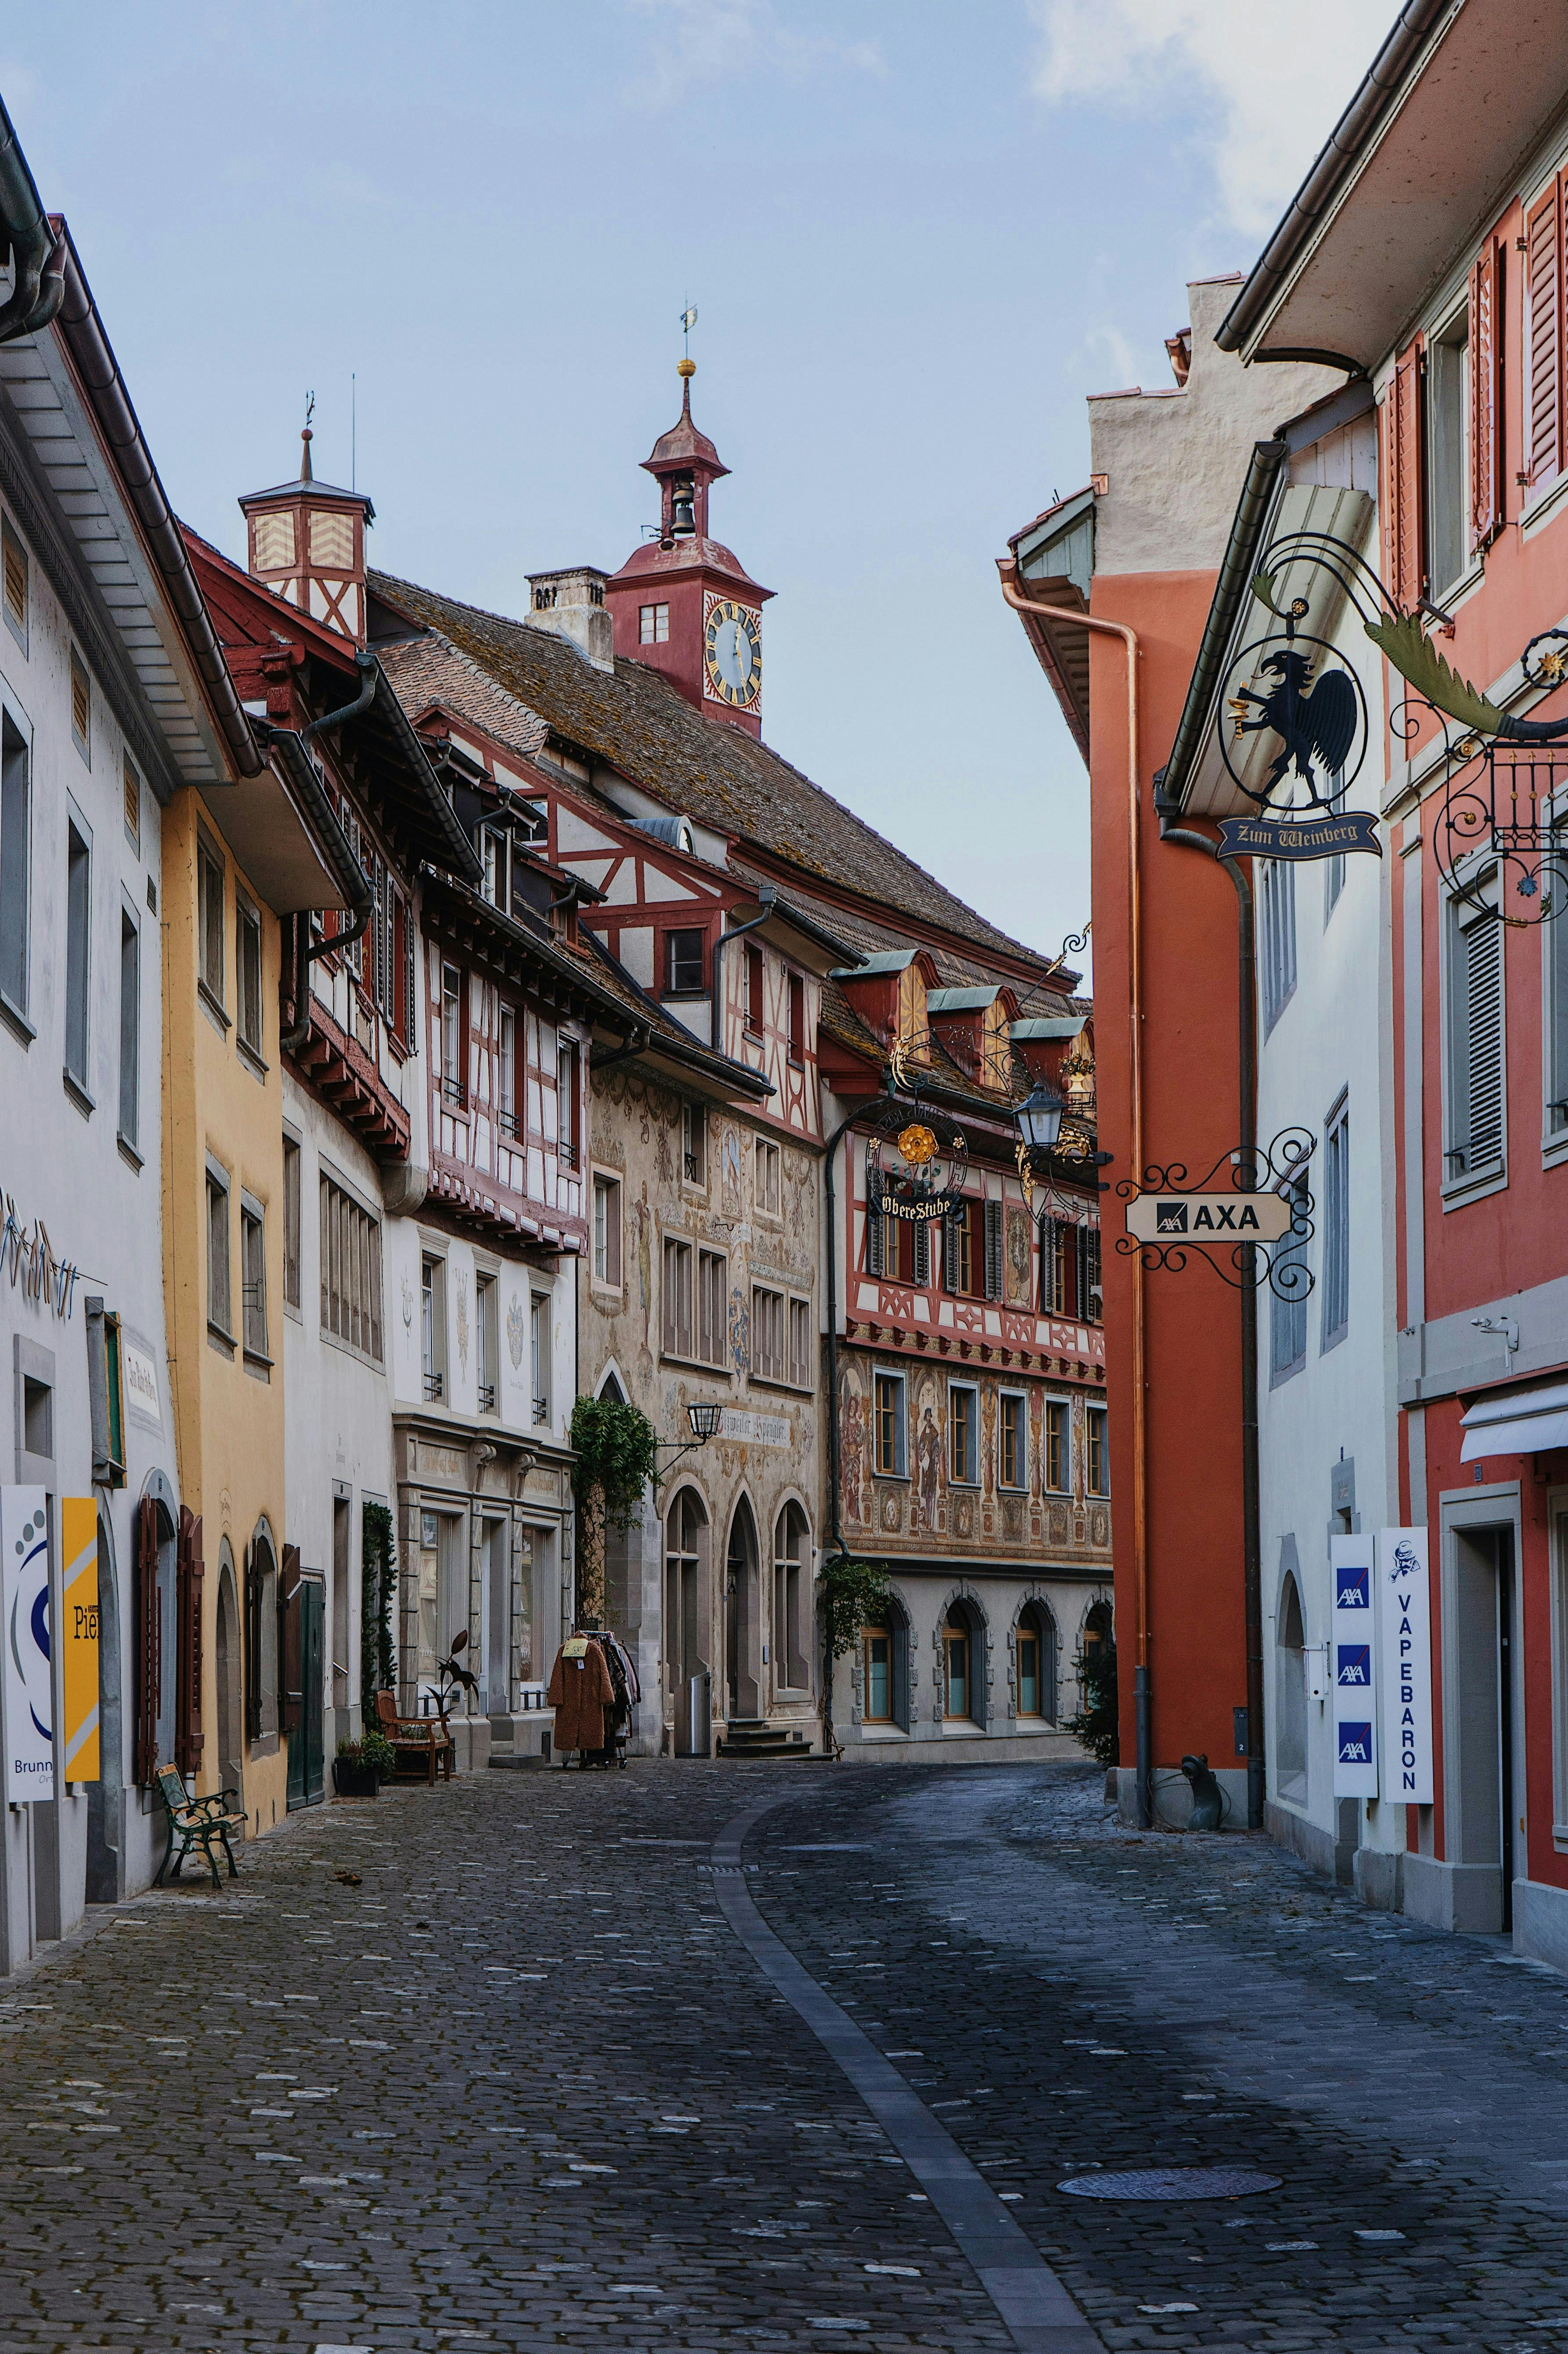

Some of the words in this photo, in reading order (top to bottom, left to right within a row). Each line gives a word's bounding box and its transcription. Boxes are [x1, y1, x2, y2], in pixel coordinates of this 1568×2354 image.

[1236, 825, 1272, 845] Zum
[1278, 825, 1359, 848] Weinberg
[1157, 1218, 1183, 1231] AXA
[1193, 1205, 1260, 1230] AXA
[1337, 1588, 1363, 1605] AXA
[73, 1606, 99, 1640] Pie
[1338, 1665, 1365, 1682] AXA
[1398, 1594, 1416, 1790] VAPEBARON
[1339, 1743, 1367, 1760] AXA
[15, 1760, 53, 1774] Brunn
